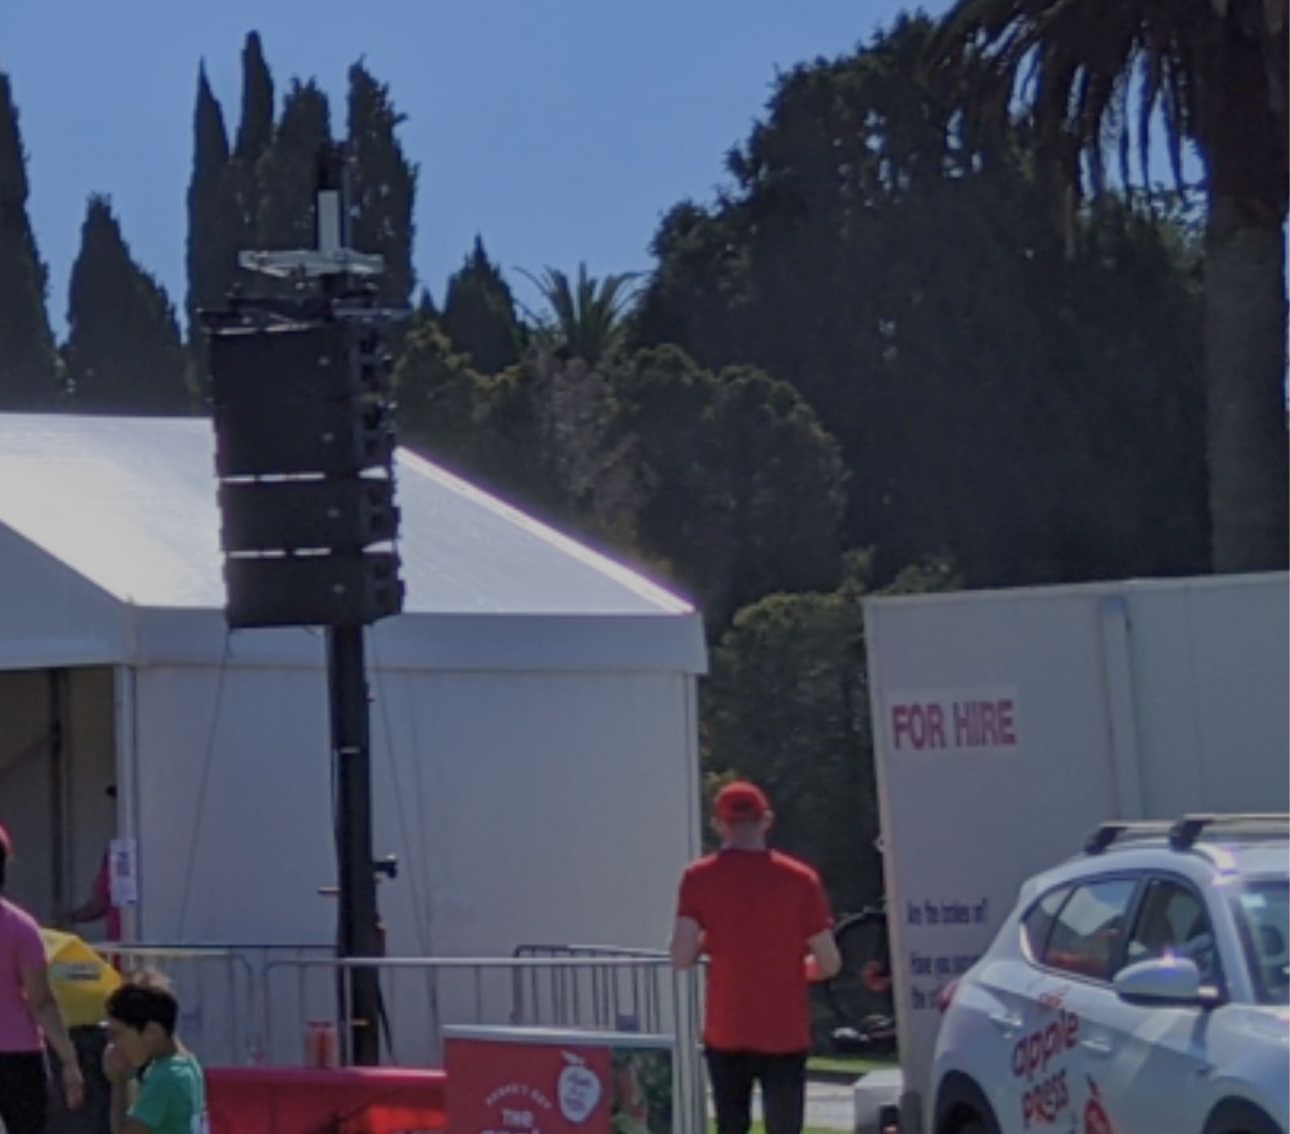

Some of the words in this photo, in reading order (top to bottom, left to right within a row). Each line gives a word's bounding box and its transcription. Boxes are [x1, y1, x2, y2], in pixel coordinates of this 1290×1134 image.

[892, 702, 948, 751] FOR
[953, 698, 1016, 747] HIRE
[1010, 1008, 1078, 1082] apple
[1022, 1067, 1069, 1133] press
